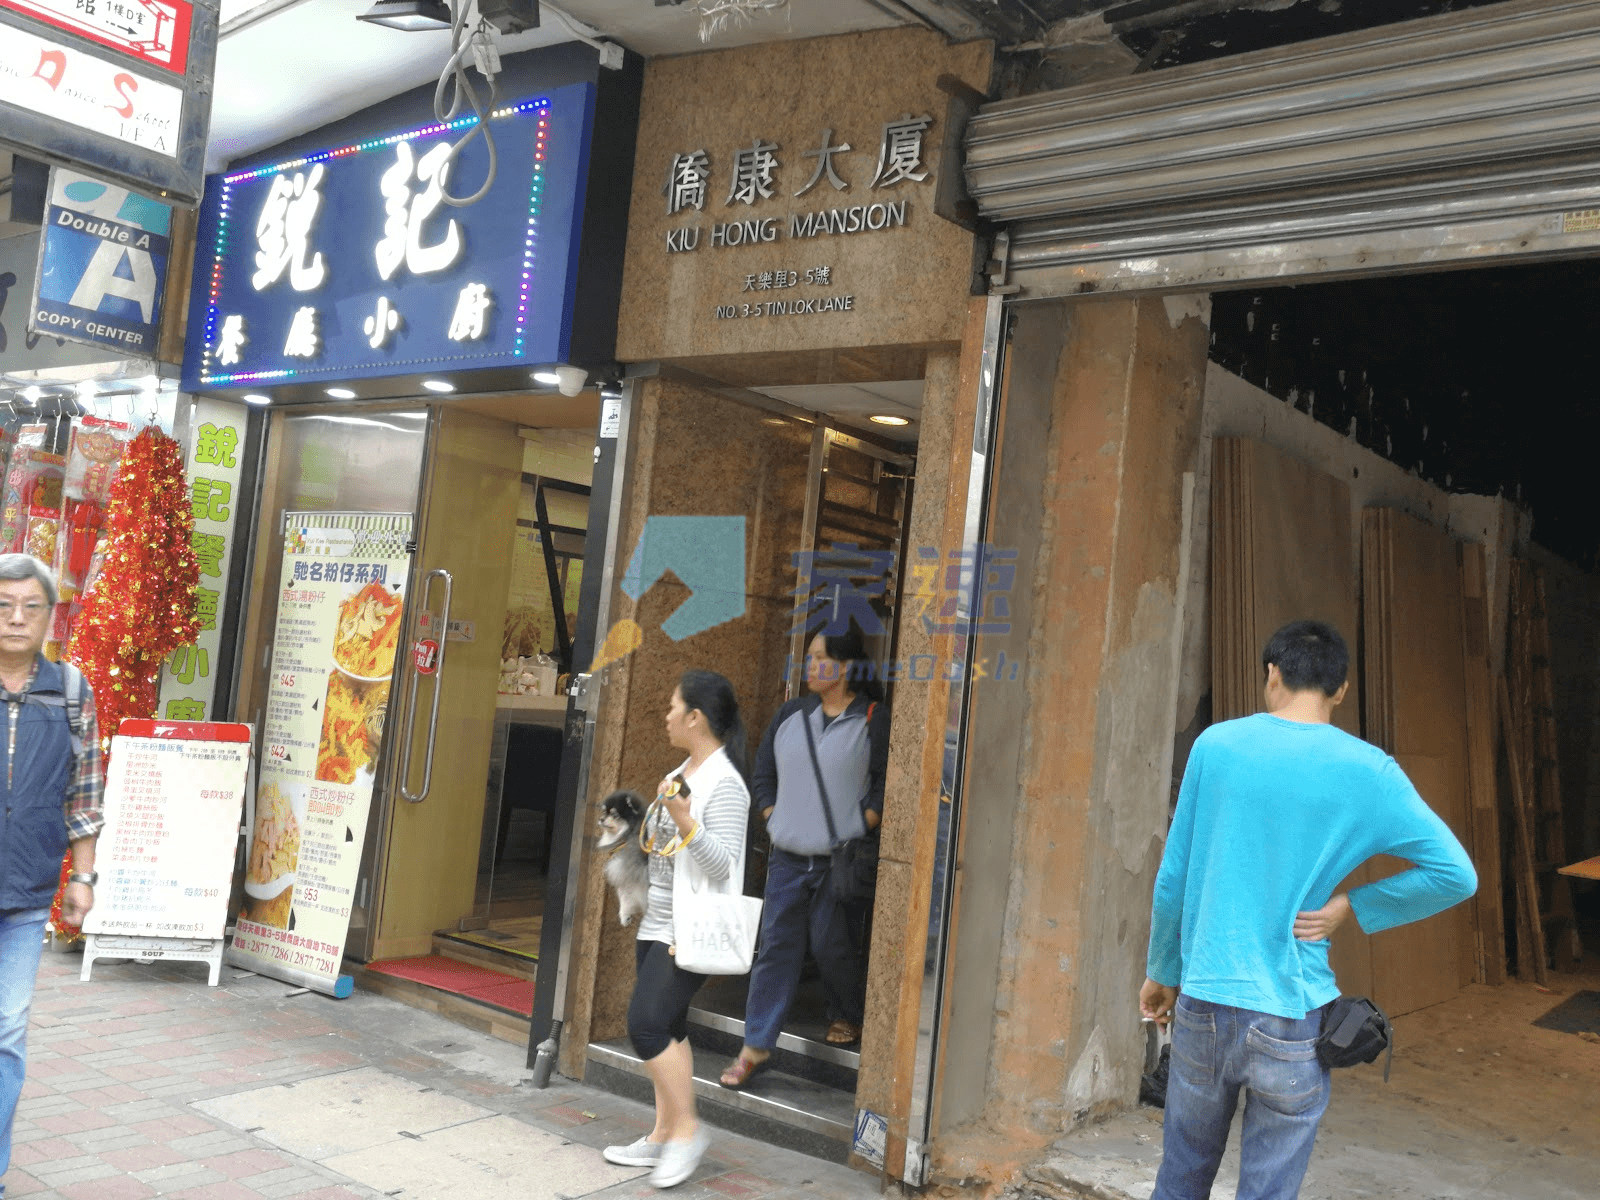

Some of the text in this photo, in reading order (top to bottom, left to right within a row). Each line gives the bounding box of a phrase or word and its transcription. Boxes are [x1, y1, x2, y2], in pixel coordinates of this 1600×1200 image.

[32, 48, 97, 103] Dance
[104, 73, 172, 130] School
[662, 113, 933, 216] 僑康大廈
[252, 141, 461, 291] 銳記
[665, 200, 907, 253] KIU HONG MANSION
[57, 210, 151, 249] Double A
[742, 265, 831, 292] 天樂里3-5號
[716, 295, 854, 319] NO. 3-5 TIN LOK LANE
[37, 310, 144, 345] COPY CENTER
[293, 561, 387, 584] 馳名粉仔系列
[281, 674, 295, 687] $45
[271, 744, 285, 758] $42
[200, 790, 234, 800] 每款$38
[184, 887, 219, 897] 每款$40
[304, 888, 318, 901] $53
